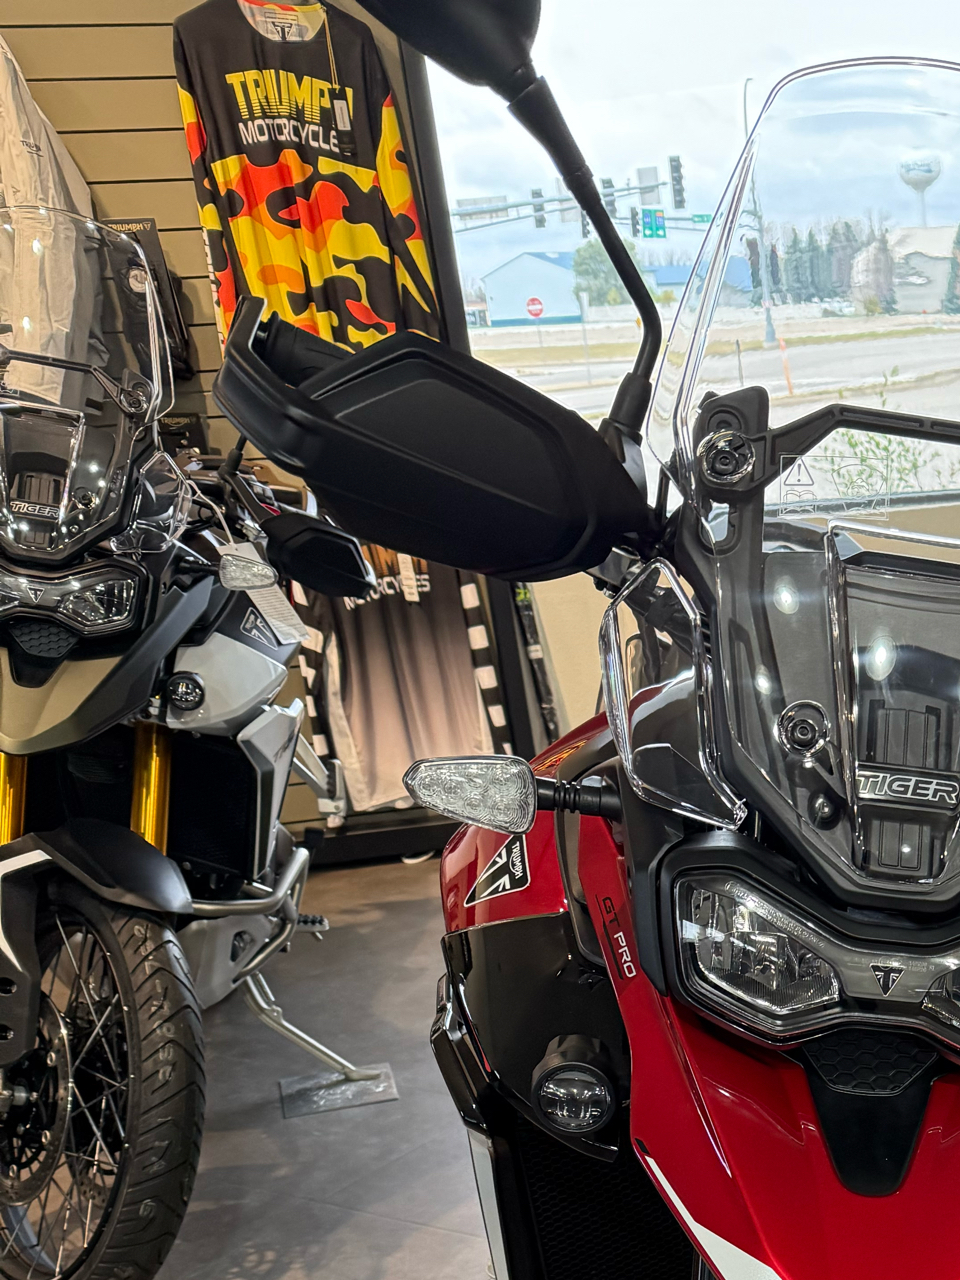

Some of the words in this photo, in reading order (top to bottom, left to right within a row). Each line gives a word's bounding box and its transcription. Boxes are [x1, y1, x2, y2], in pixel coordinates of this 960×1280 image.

[238, 118, 340, 153] MOTORCYCLE
[10, 501, 61, 517] TIGER
[856, 771, 959, 804] TIGER
[511, 841, 524, 880] TRIUMPH
[602, 896, 621, 928] GT
[613, 931, 637, 978] PRO
